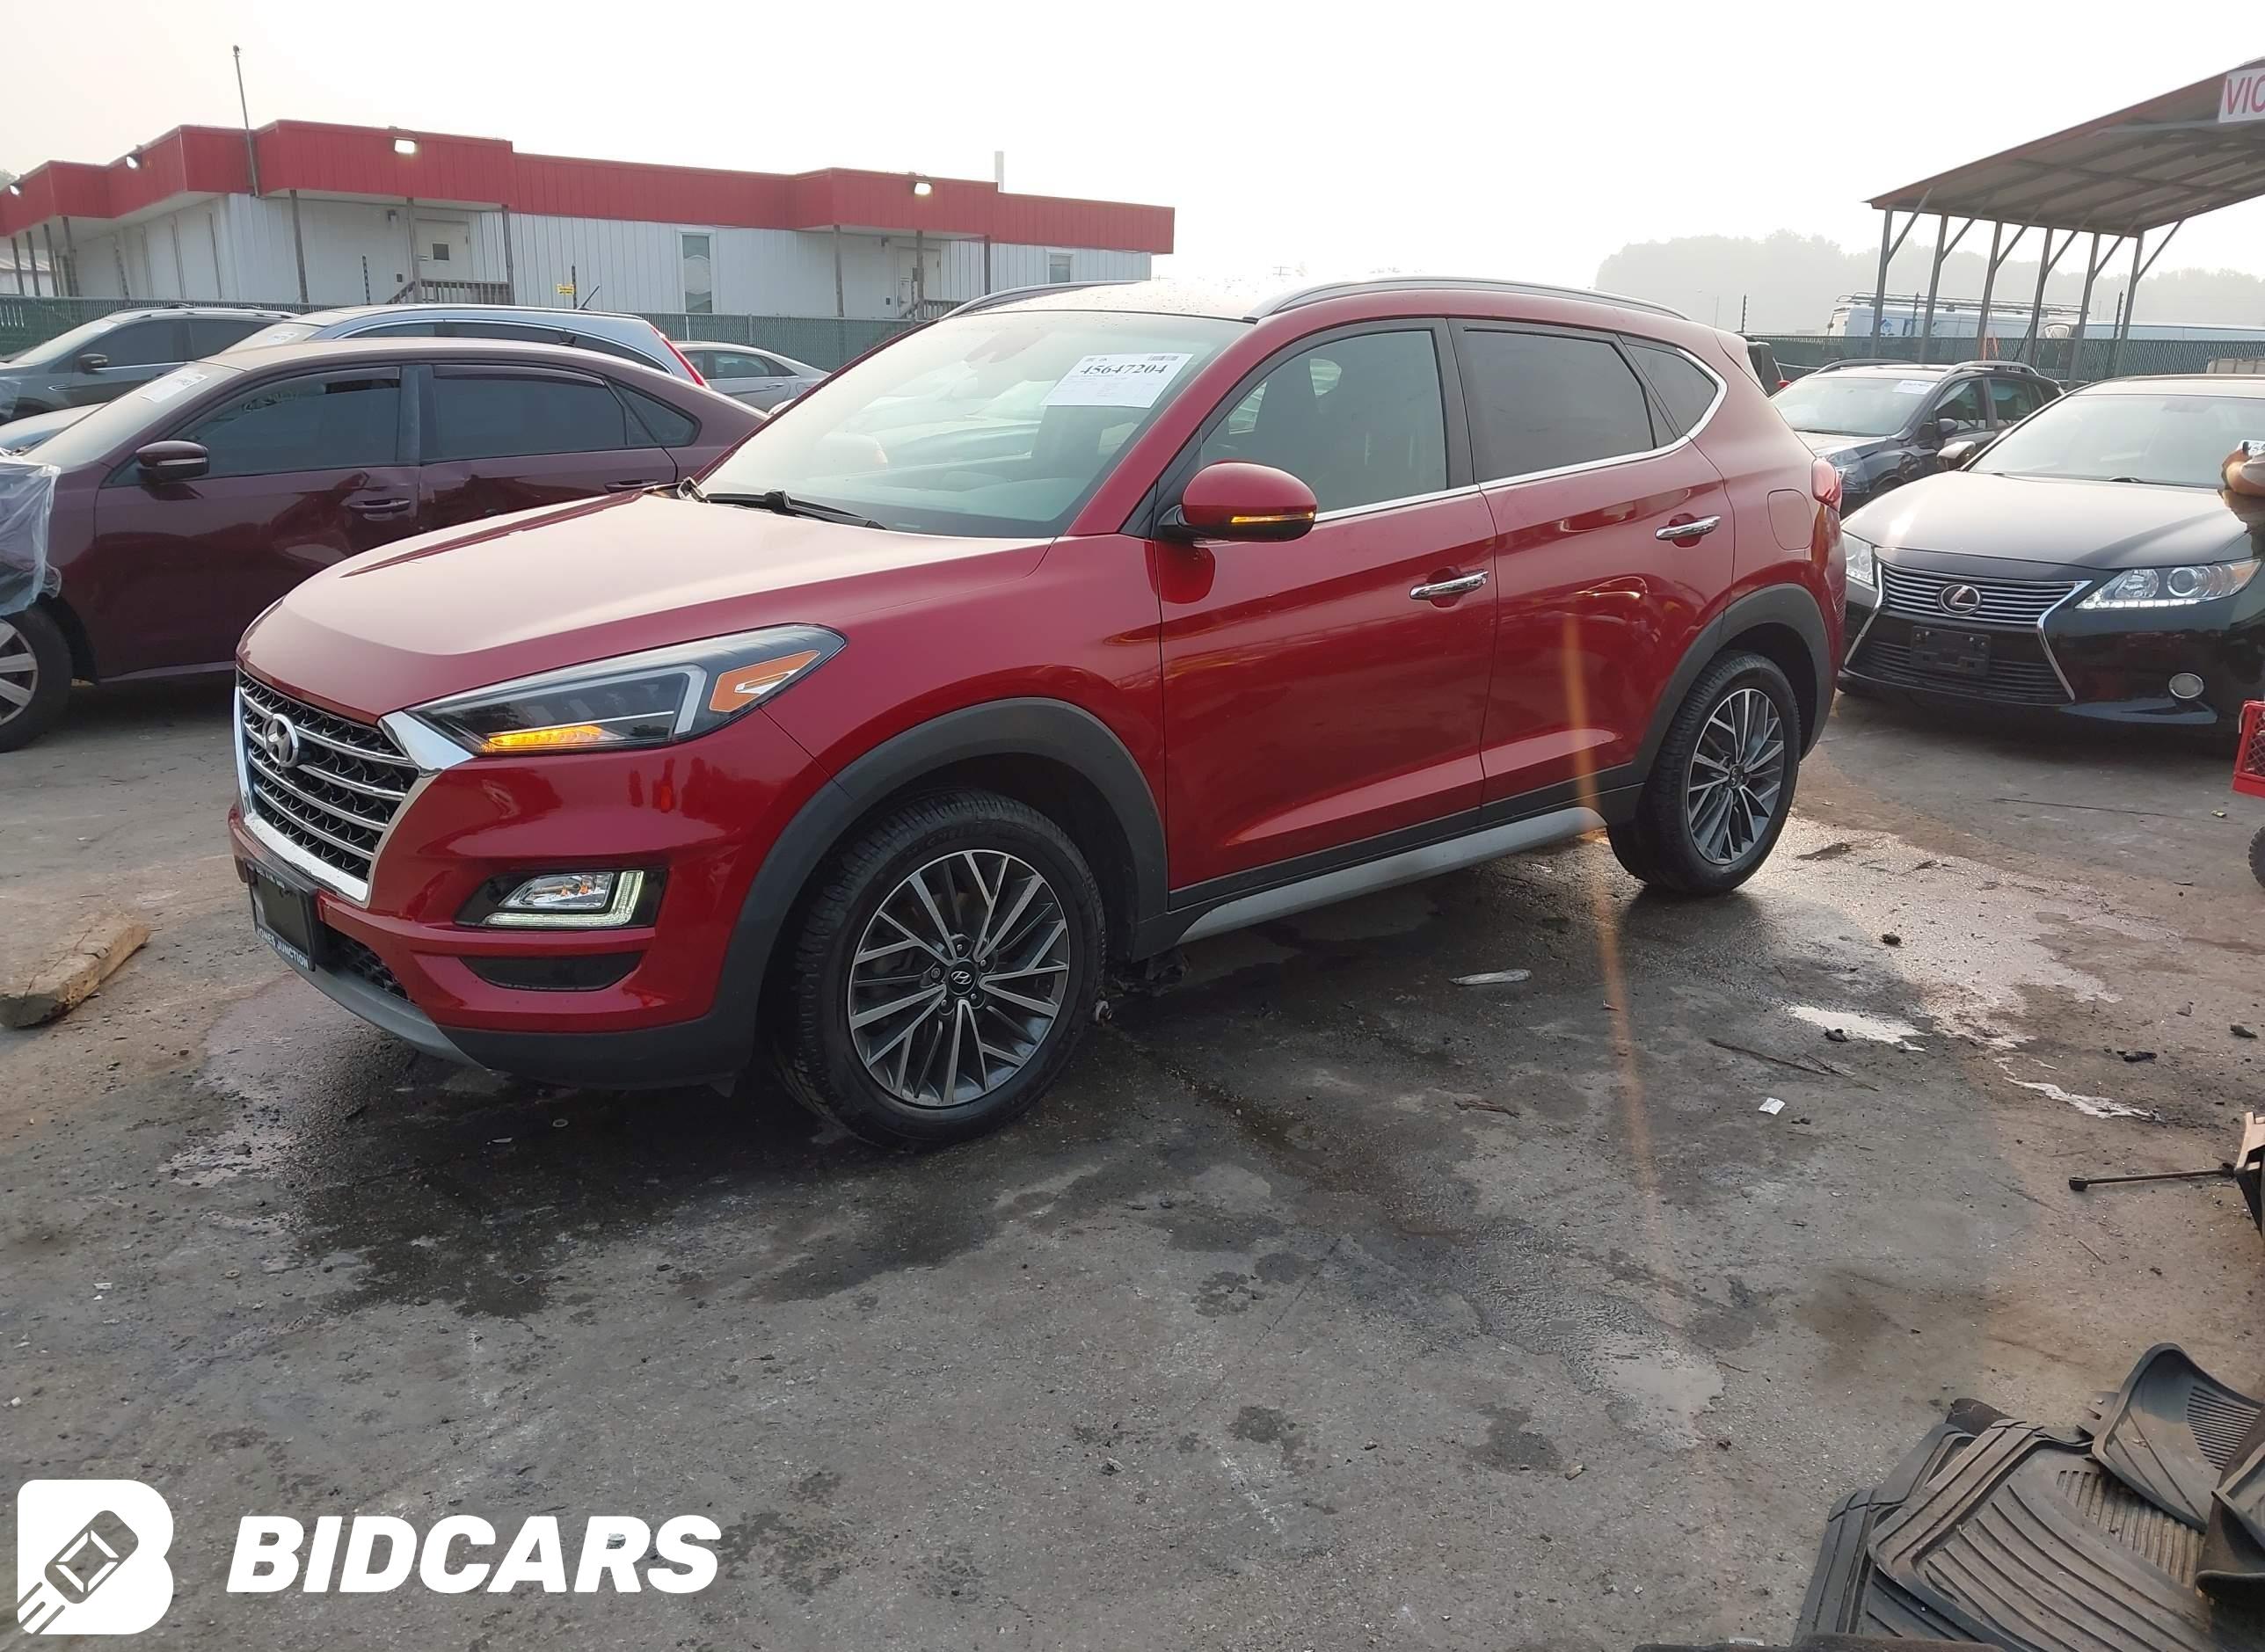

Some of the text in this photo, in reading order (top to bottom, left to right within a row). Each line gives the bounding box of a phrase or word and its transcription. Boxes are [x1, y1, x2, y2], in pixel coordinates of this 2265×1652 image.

[1080, 363, 1169, 375] 45647204
[256, 927, 309, 970] JONES JUNCTION
